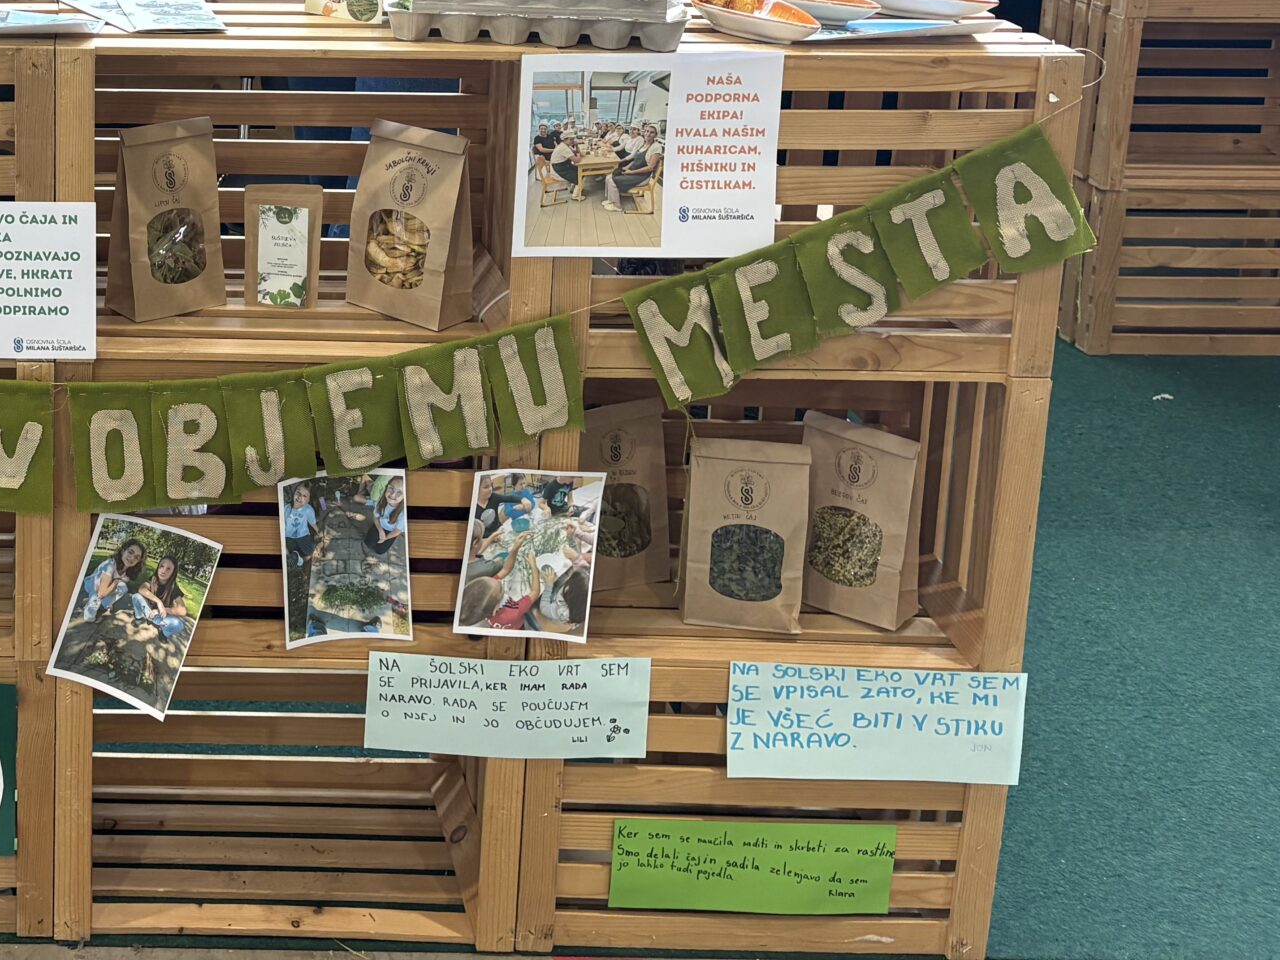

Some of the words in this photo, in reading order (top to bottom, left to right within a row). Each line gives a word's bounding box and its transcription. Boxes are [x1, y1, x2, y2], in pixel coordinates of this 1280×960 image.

[706, 72, 742, 85] NAŠA
[686, 92, 759, 103] PODPORNA
[699, 111, 743, 120] EKIPA!
[675, 128, 718, 137] HVALA
[722, 125, 765, 137] NAŠIM
[385, 151, 416, 171] JABOLČNI
[681, 159, 737, 172] HIŠNIKU
[741, 163, 755, 172] IN
[680, 177, 755, 190] ČISTILKAM.
[19, 213, 57, 225] ČAJA
[62, 215, 78, 225] IN
[21, 269, 73, 280] HKRATI
[636, 161, 1078, 401] MESTA
[379, 658, 400, 672] NA
[430, 658, 484, 675] ŠOLSKI
[509, 664, 539, 677] EKO
[558, 665, 581, 676] VRT
[601, 662, 629, 677] SEM
[732, 662, 759, 675] NA
[857, 670, 902, 682] EKO
[915, 673, 961, 686] VRT
[968, 676, 1019, 690] SEM
[379, 676, 395, 687] SE
[412, 677, 482, 692] PRIJAVILA,
[486, 683, 507, 691] KER
[520, 683, 545, 691] IMAM
[562, 682, 587, 690] RADA
[379, 692, 435, 706] NARAVO.
[443, 697, 477, 710] RADA
[492, 702, 507, 711] SE
[522, 699, 588, 711] POUČUJEM
[732, 684, 761, 702] SE
[773, 685, 848, 699] VPISAL
[861, 687, 922, 704] ZATO,
[930, 691, 959, 704] KE
[972, 693, 998, 706] MI
[404, 712, 436, 721] NJEJ
[484, 719, 499, 728] JO
[729, 708, 756, 726] JE
[853, 712, 902, 729] BITI
[912, 714, 928, 731] V
[935, 717, 1003, 736] STIKU
[731, 732, 744, 750] Z
[753, 732, 856, 749] NARAVO.
[618, 825, 639, 839] Ker
[648, 832, 670, 840] sem
[680, 835, 690, 843] se
[617, 844, 640, 857] Smo
[647, 847, 680, 859] delali
[770, 862, 820, 884] zelenjavo
[829, 872, 842, 884] da
[637, 858, 664, 869] lahko
[671, 861, 693, 874] tudi
[697, 867, 734, 880] pojedla
